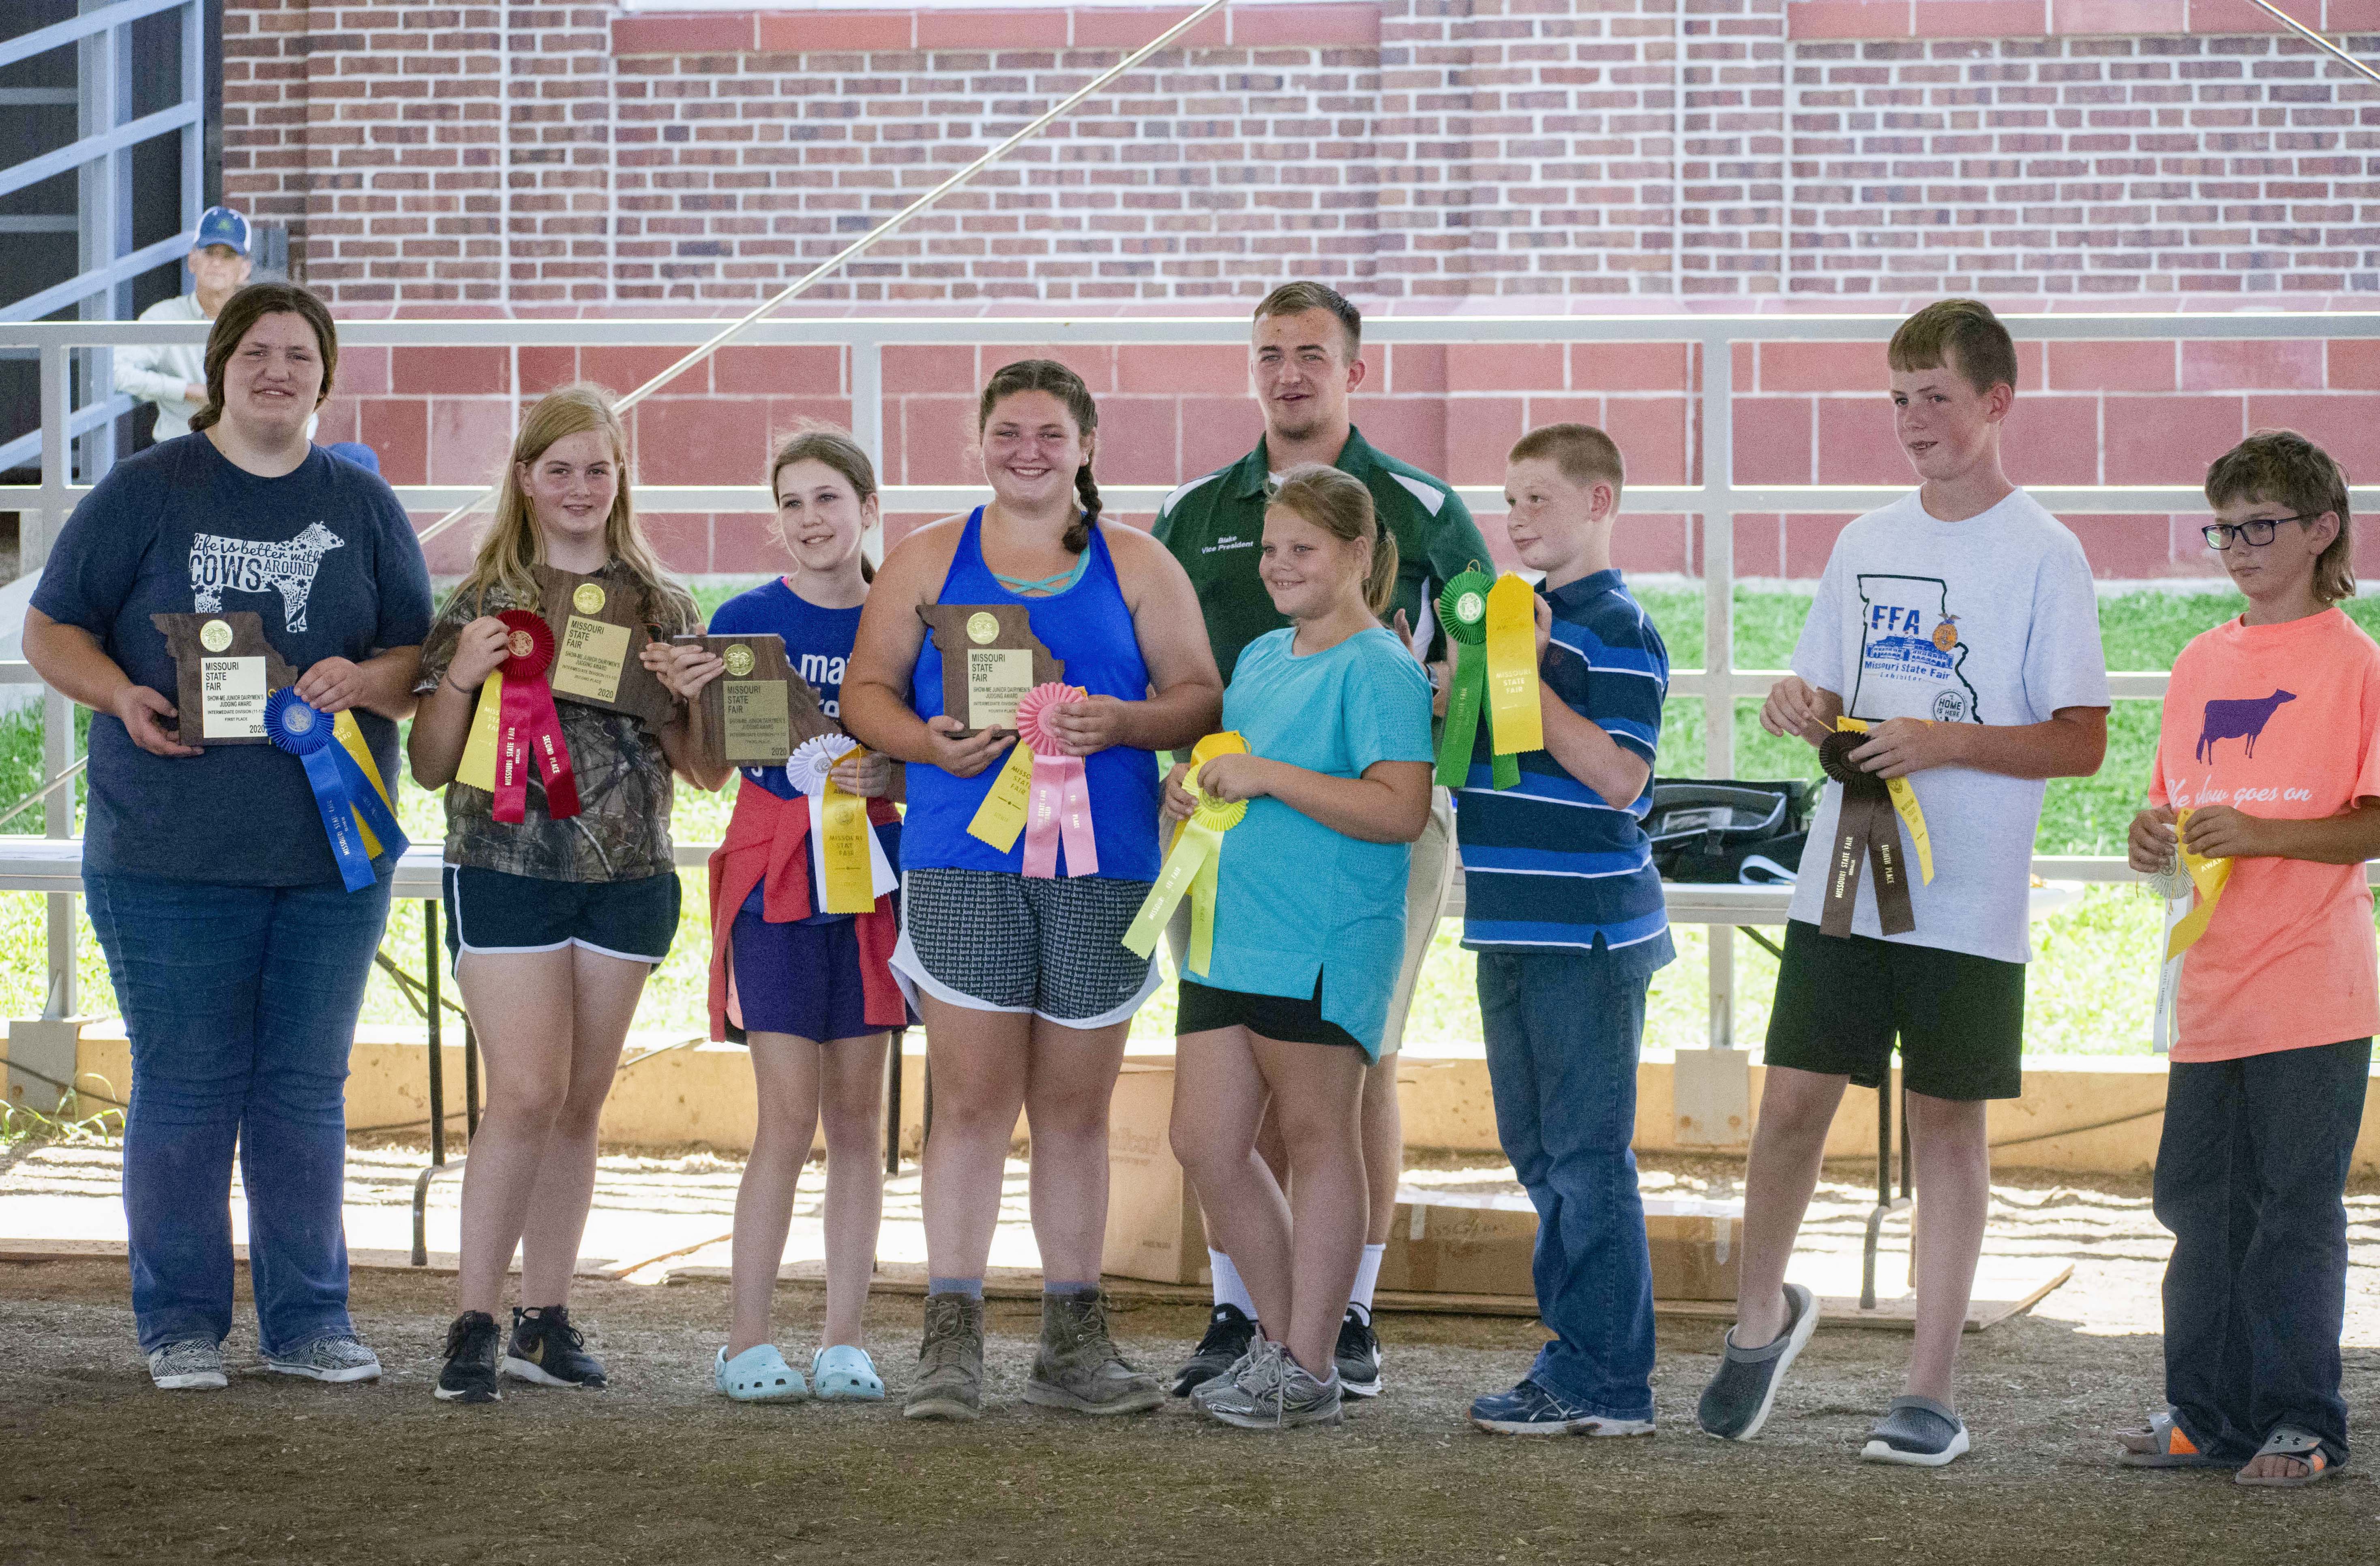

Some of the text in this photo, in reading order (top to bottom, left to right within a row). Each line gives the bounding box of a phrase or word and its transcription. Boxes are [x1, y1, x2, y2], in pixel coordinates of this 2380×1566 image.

[192, 534, 321, 563] life is better with
[1218, 541, 1254, 551] President
[190, 554, 314, 591] COWS AROUND
[1872, 605, 1920, 635] FFA
[571, 620, 604, 635] MISSOURI
[569, 629, 590, 641] STATE
[567, 639, 582, 649] FAIR
[972, 654, 1005, 662] MISSOURI
[206, 662, 239, 671] MISSOURI
[972, 664, 993, 672] STATE
[1865, 661, 1950, 679] Missouri State Fair
[206, 672, 227, 680] STATE
[1496, 669, 1531, 679] MISSOURI
[206, 682, 221, 691] FAIR
[1503, 678, 1525, 686] STATE
[598, 688, 613, 698] 2020
[727, 686, 761, 694] MISSOURI
[728, 695, 748, 704] STATE
[1939, 698, 1962, 710] HOME
[728, 706, 743, 714] FAIR
[249, 725, 265, 733] 2020
[542, 734, 560, 774] SECOND PLACE
[505, 759, 513, 785] MISSOURI
[1010, 783, 1026, 795] FAIR
[2234, 787, 2278, 809] goes
[2284, 787, 2312, 802] on
[337, 831, 350, 856] MISSOURI
[1835, 836, 1853, 899] MISSOURI STATE FAIR
[1882, 844, 1895, 884] EIGHTH PLACE
[1148, 896, 1165, 920] MISSOURI
[1171, 867, 1181, 879] FAIR
